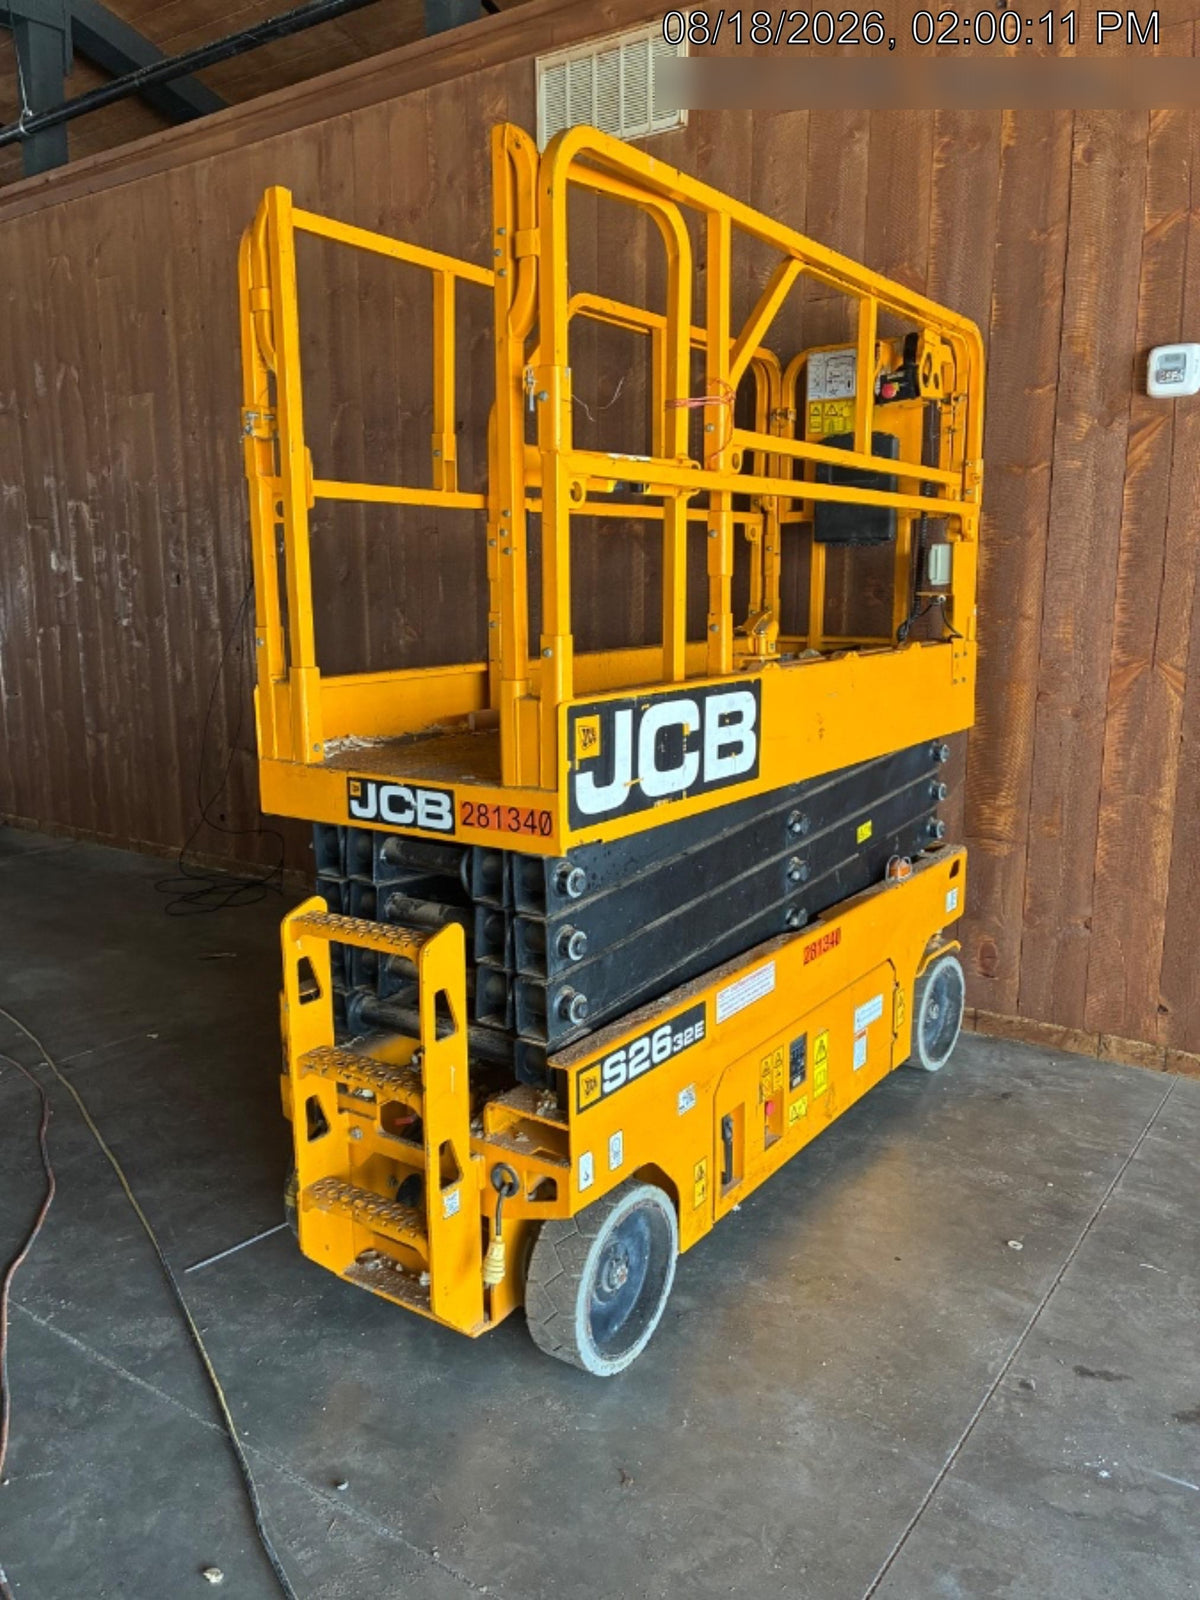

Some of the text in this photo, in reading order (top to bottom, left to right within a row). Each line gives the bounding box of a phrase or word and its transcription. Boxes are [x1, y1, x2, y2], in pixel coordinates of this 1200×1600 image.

[575, 691, 757, 815] JCB
[350, 782, 453, 830] JCB
[461, 801, 553, 837] 281340
